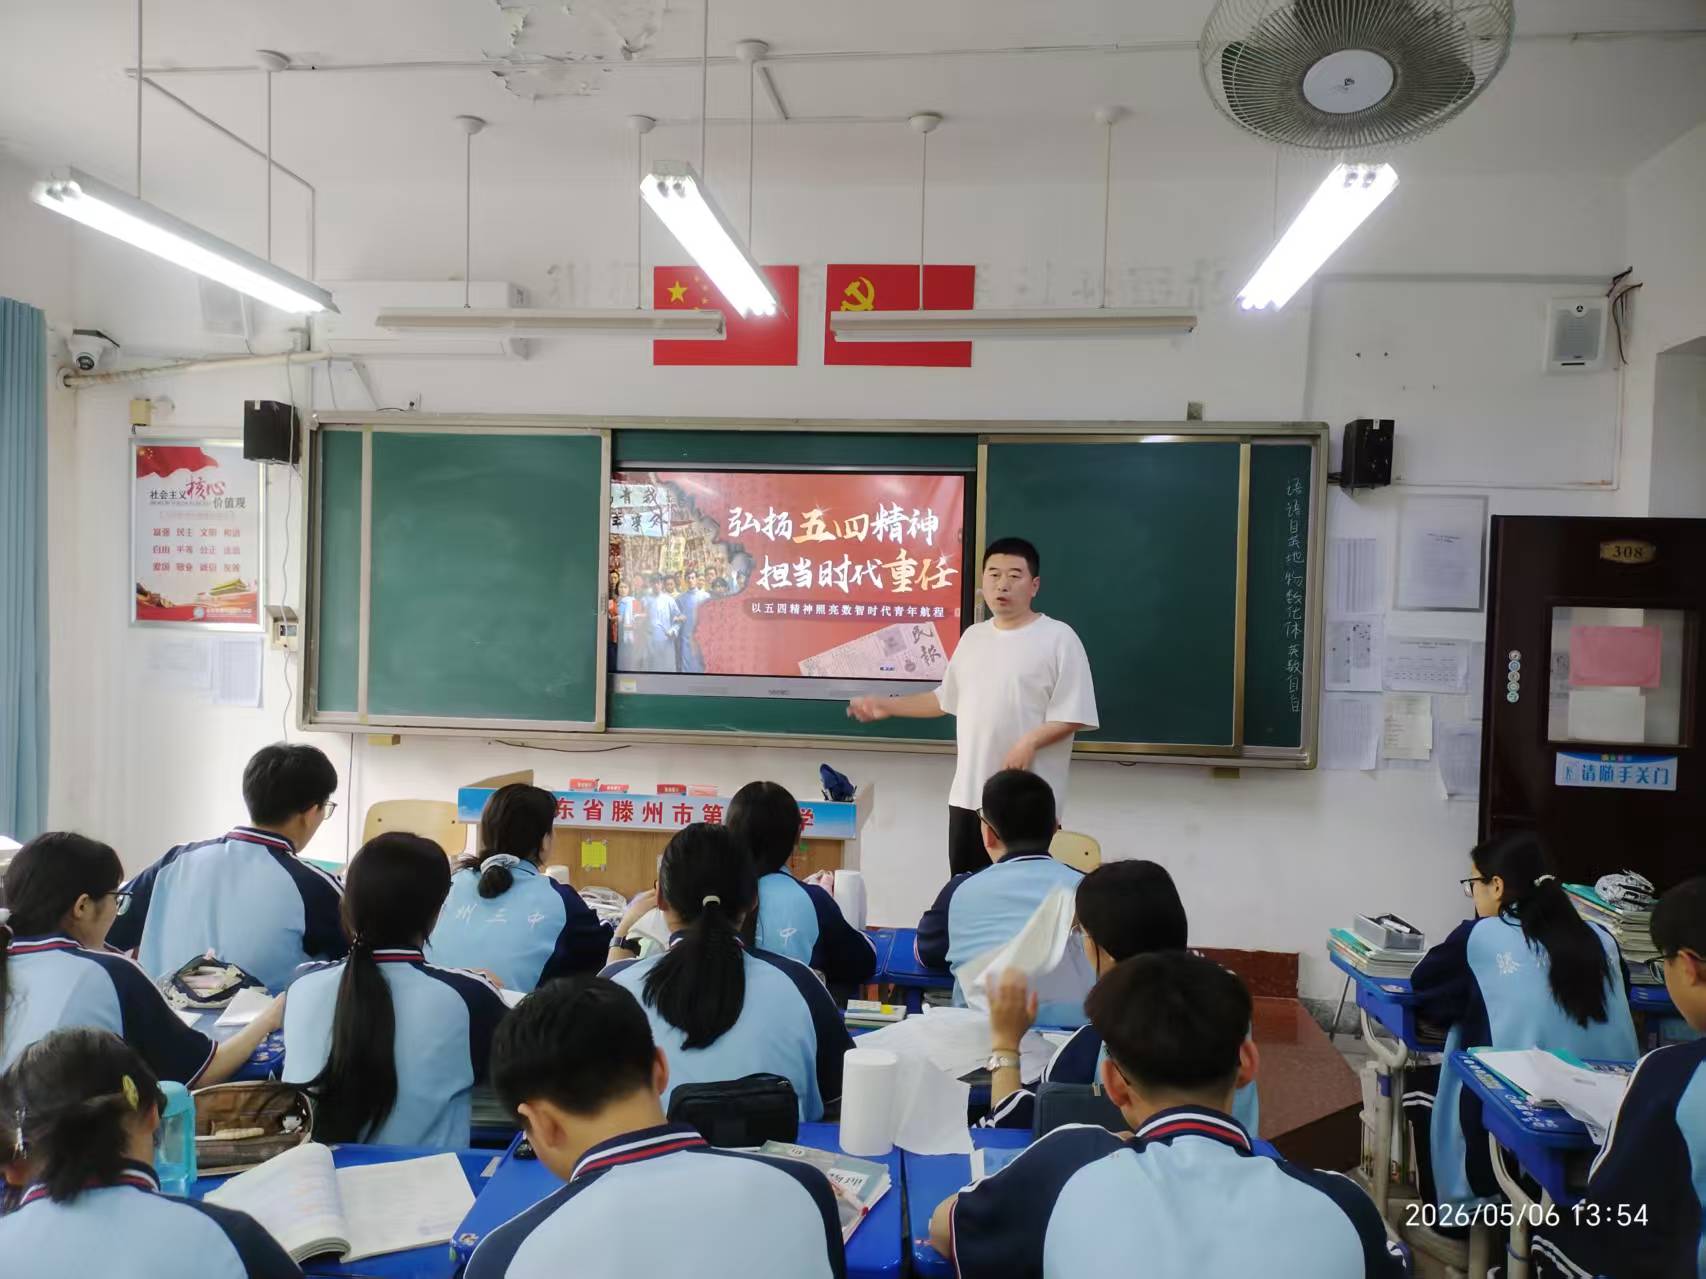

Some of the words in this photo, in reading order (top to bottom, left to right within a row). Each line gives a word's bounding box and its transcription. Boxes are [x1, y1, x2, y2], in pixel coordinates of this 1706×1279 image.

[149, 489, 187, 500] 社会主义
[186, 477, 226, 500] 核心
[213, 496, 246, 509] 价值观
[728, 502, 939, 546] 弘扬五四精神
[1612, 545, 1643, 560] 308
[756, 548, 959, 593] 担当时代重任
[751, 602, 945, 618] 以五四精神照亮数智时代青年航程
[1582, 763, 1669, 785] 请随手关门
[557, 797, 814, 833] 东省滕州市第学
